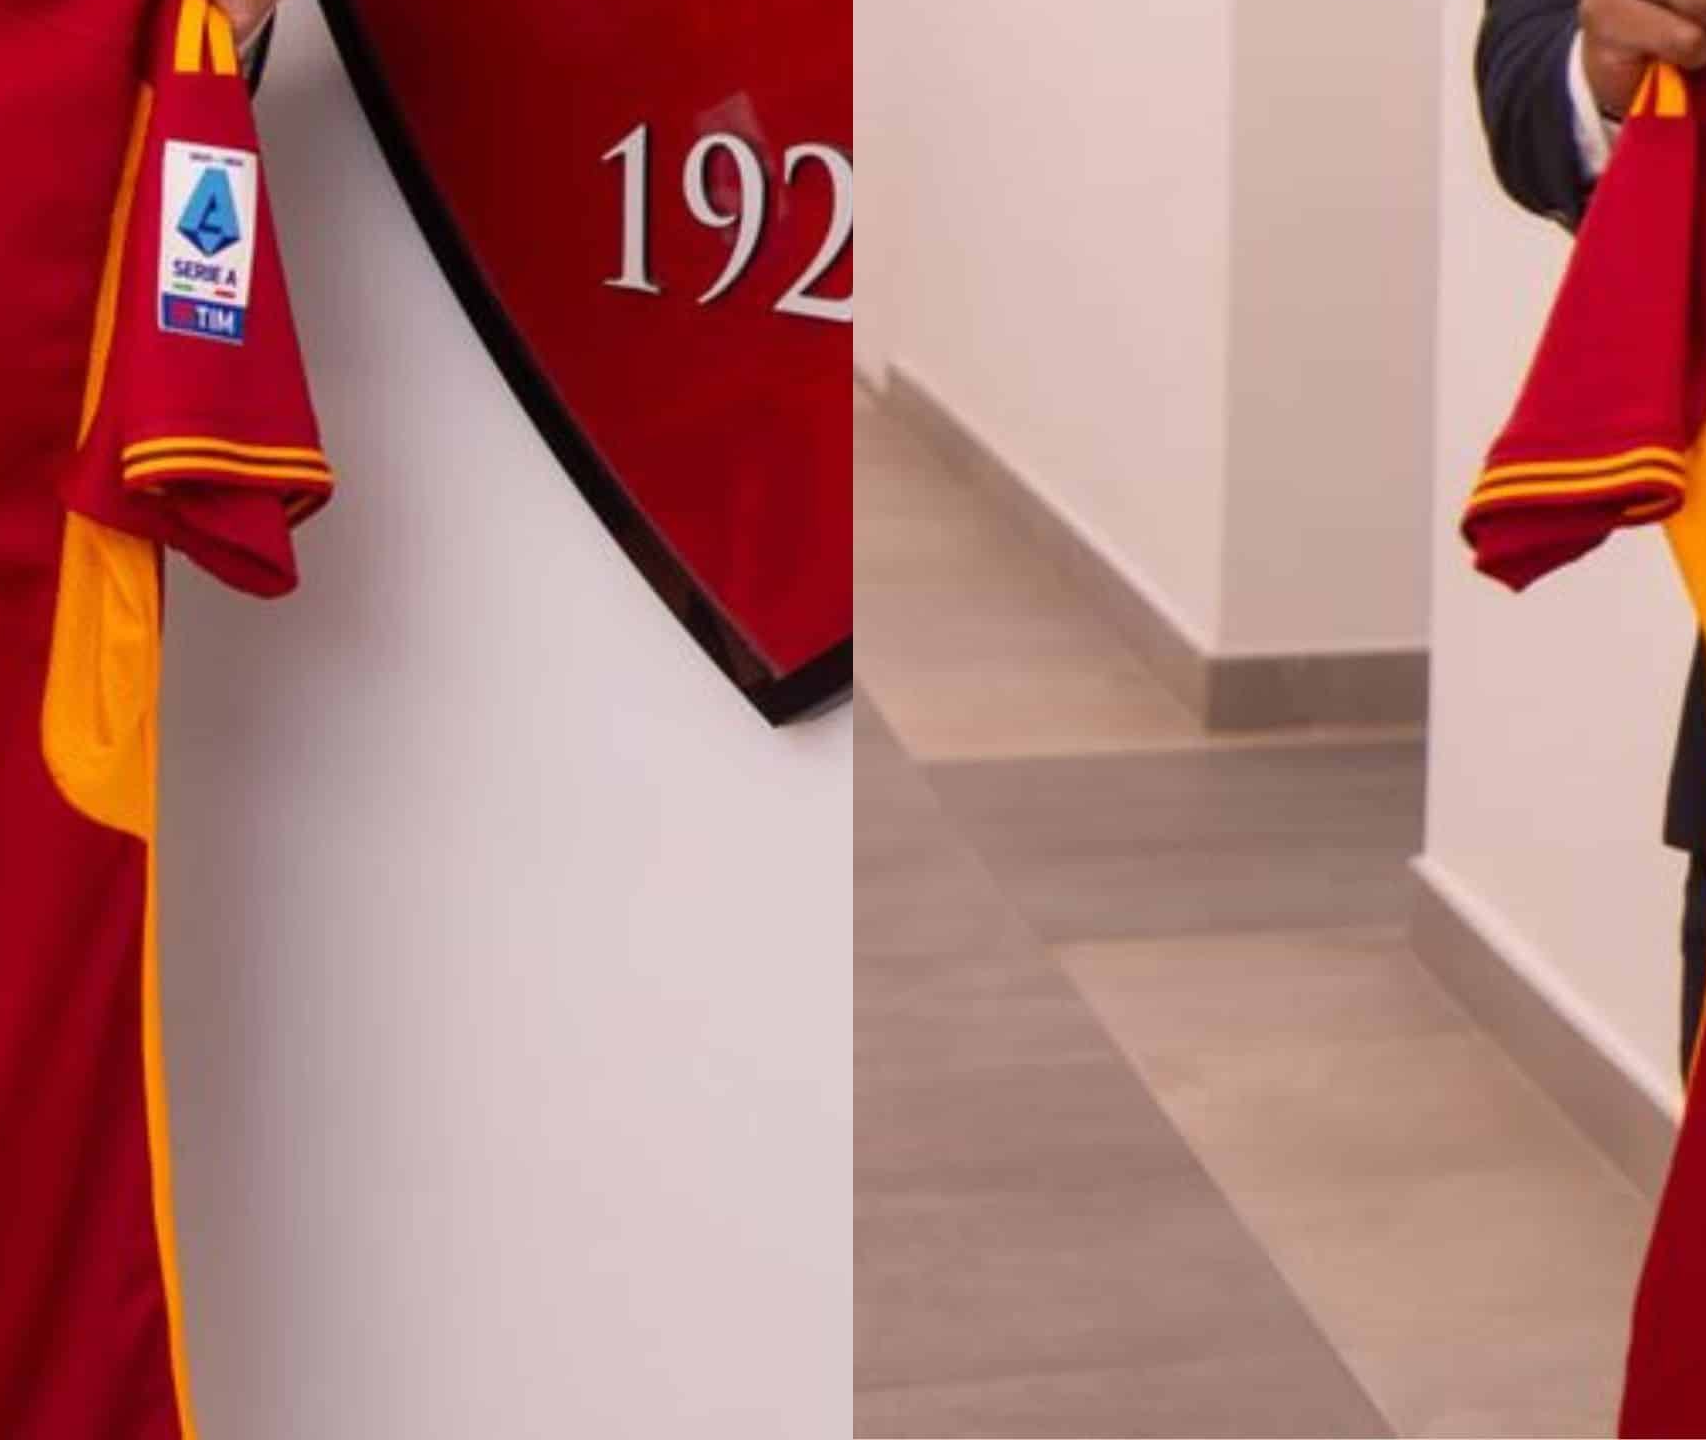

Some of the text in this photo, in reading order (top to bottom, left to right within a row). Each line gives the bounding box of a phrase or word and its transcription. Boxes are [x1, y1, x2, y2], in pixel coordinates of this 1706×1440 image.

[172, 259, 238, 287] SERIE A
[195, 306, 235, 335] TIM
